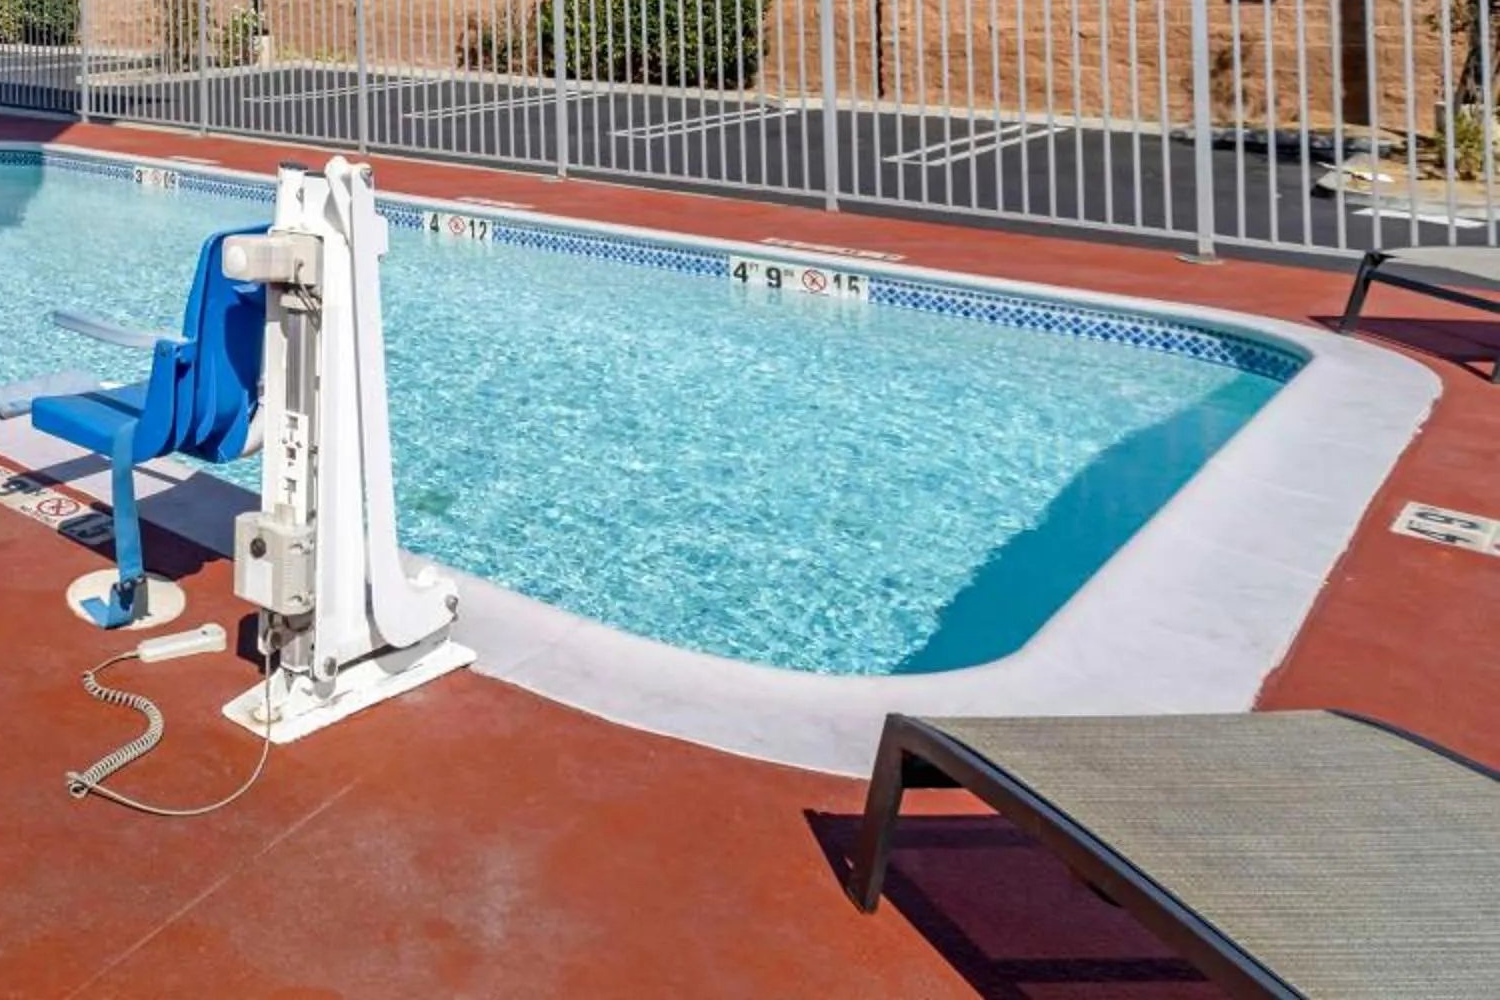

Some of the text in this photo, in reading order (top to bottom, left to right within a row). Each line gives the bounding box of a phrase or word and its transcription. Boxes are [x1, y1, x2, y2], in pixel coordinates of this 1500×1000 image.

[430, 212, 439, 232] 4
[733, 261, 748, 283] 4
[765, 267, 782, 288] 9
